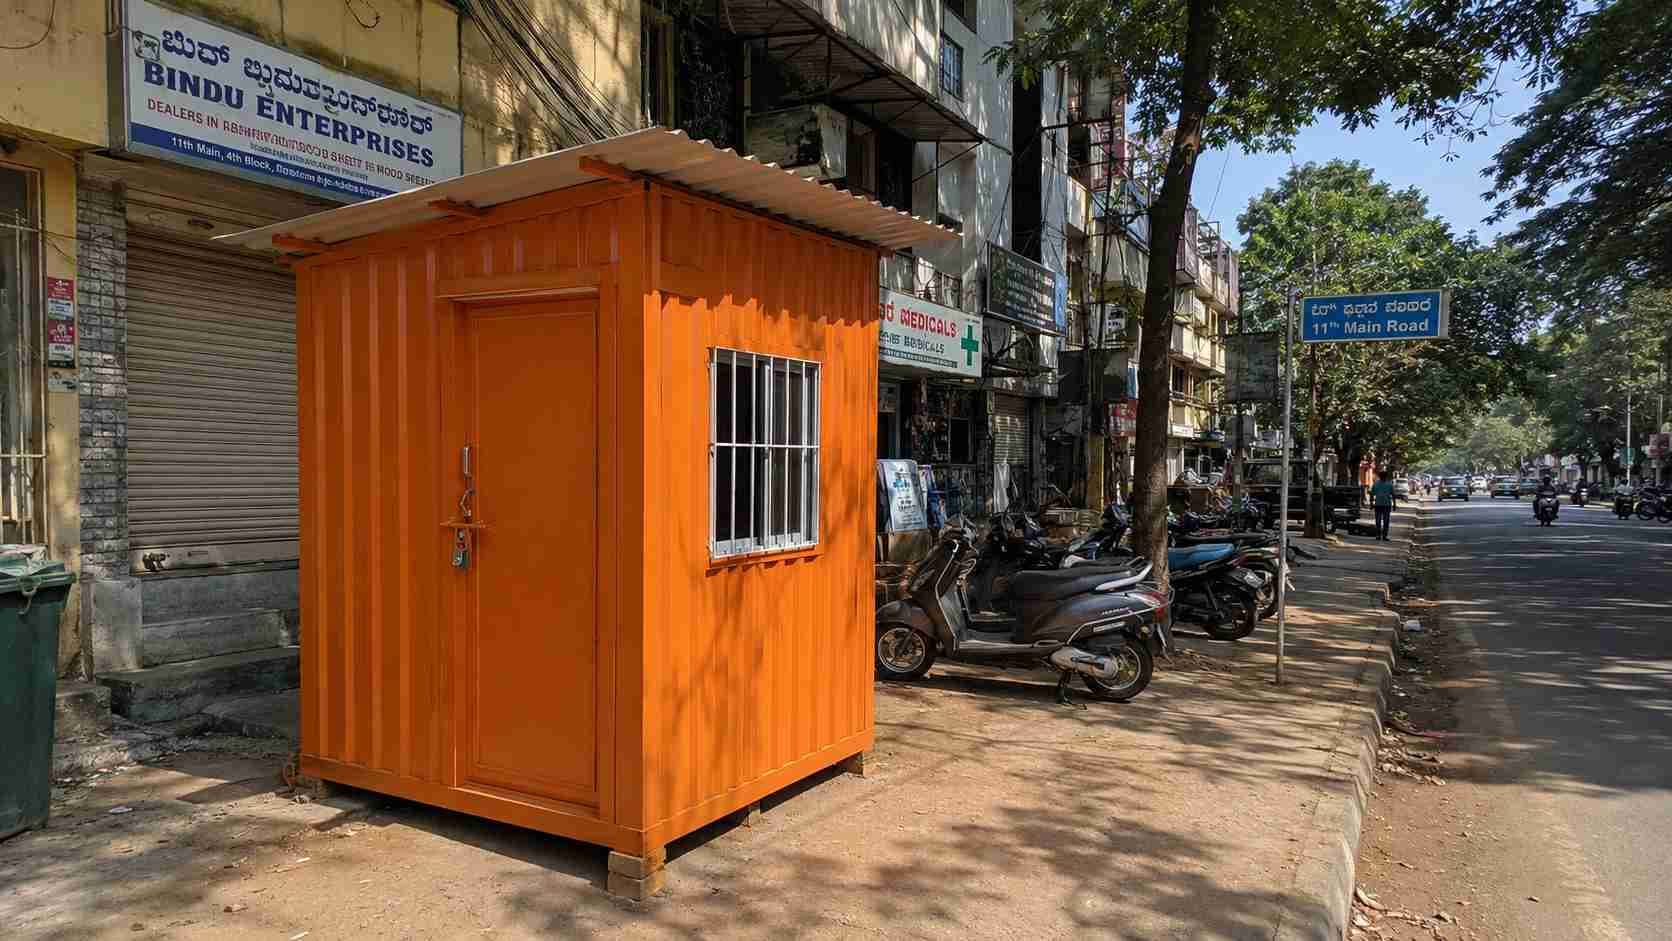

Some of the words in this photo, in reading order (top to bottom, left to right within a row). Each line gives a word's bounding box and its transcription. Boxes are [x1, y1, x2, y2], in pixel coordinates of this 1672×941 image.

[144, 60, 244, 109] BINDU
[256, 95, 433, 167] ENTERPRISES
[147, 98, 202, 124] DEALERS
[206, 115, 219, 129] IN
[171, 137, 194, 150] 11th
[196, 143, 224, 162] Main,
[225, 151, 242, 163] 4th
[245, 156, 275, 173] Block,
[900, 308, 957, 338] MEDICALS
[1312, 321, 1340, 335] 11th
[1344, 320, 1381, 334] Main
[1387, 318, 1429, 332] Road
